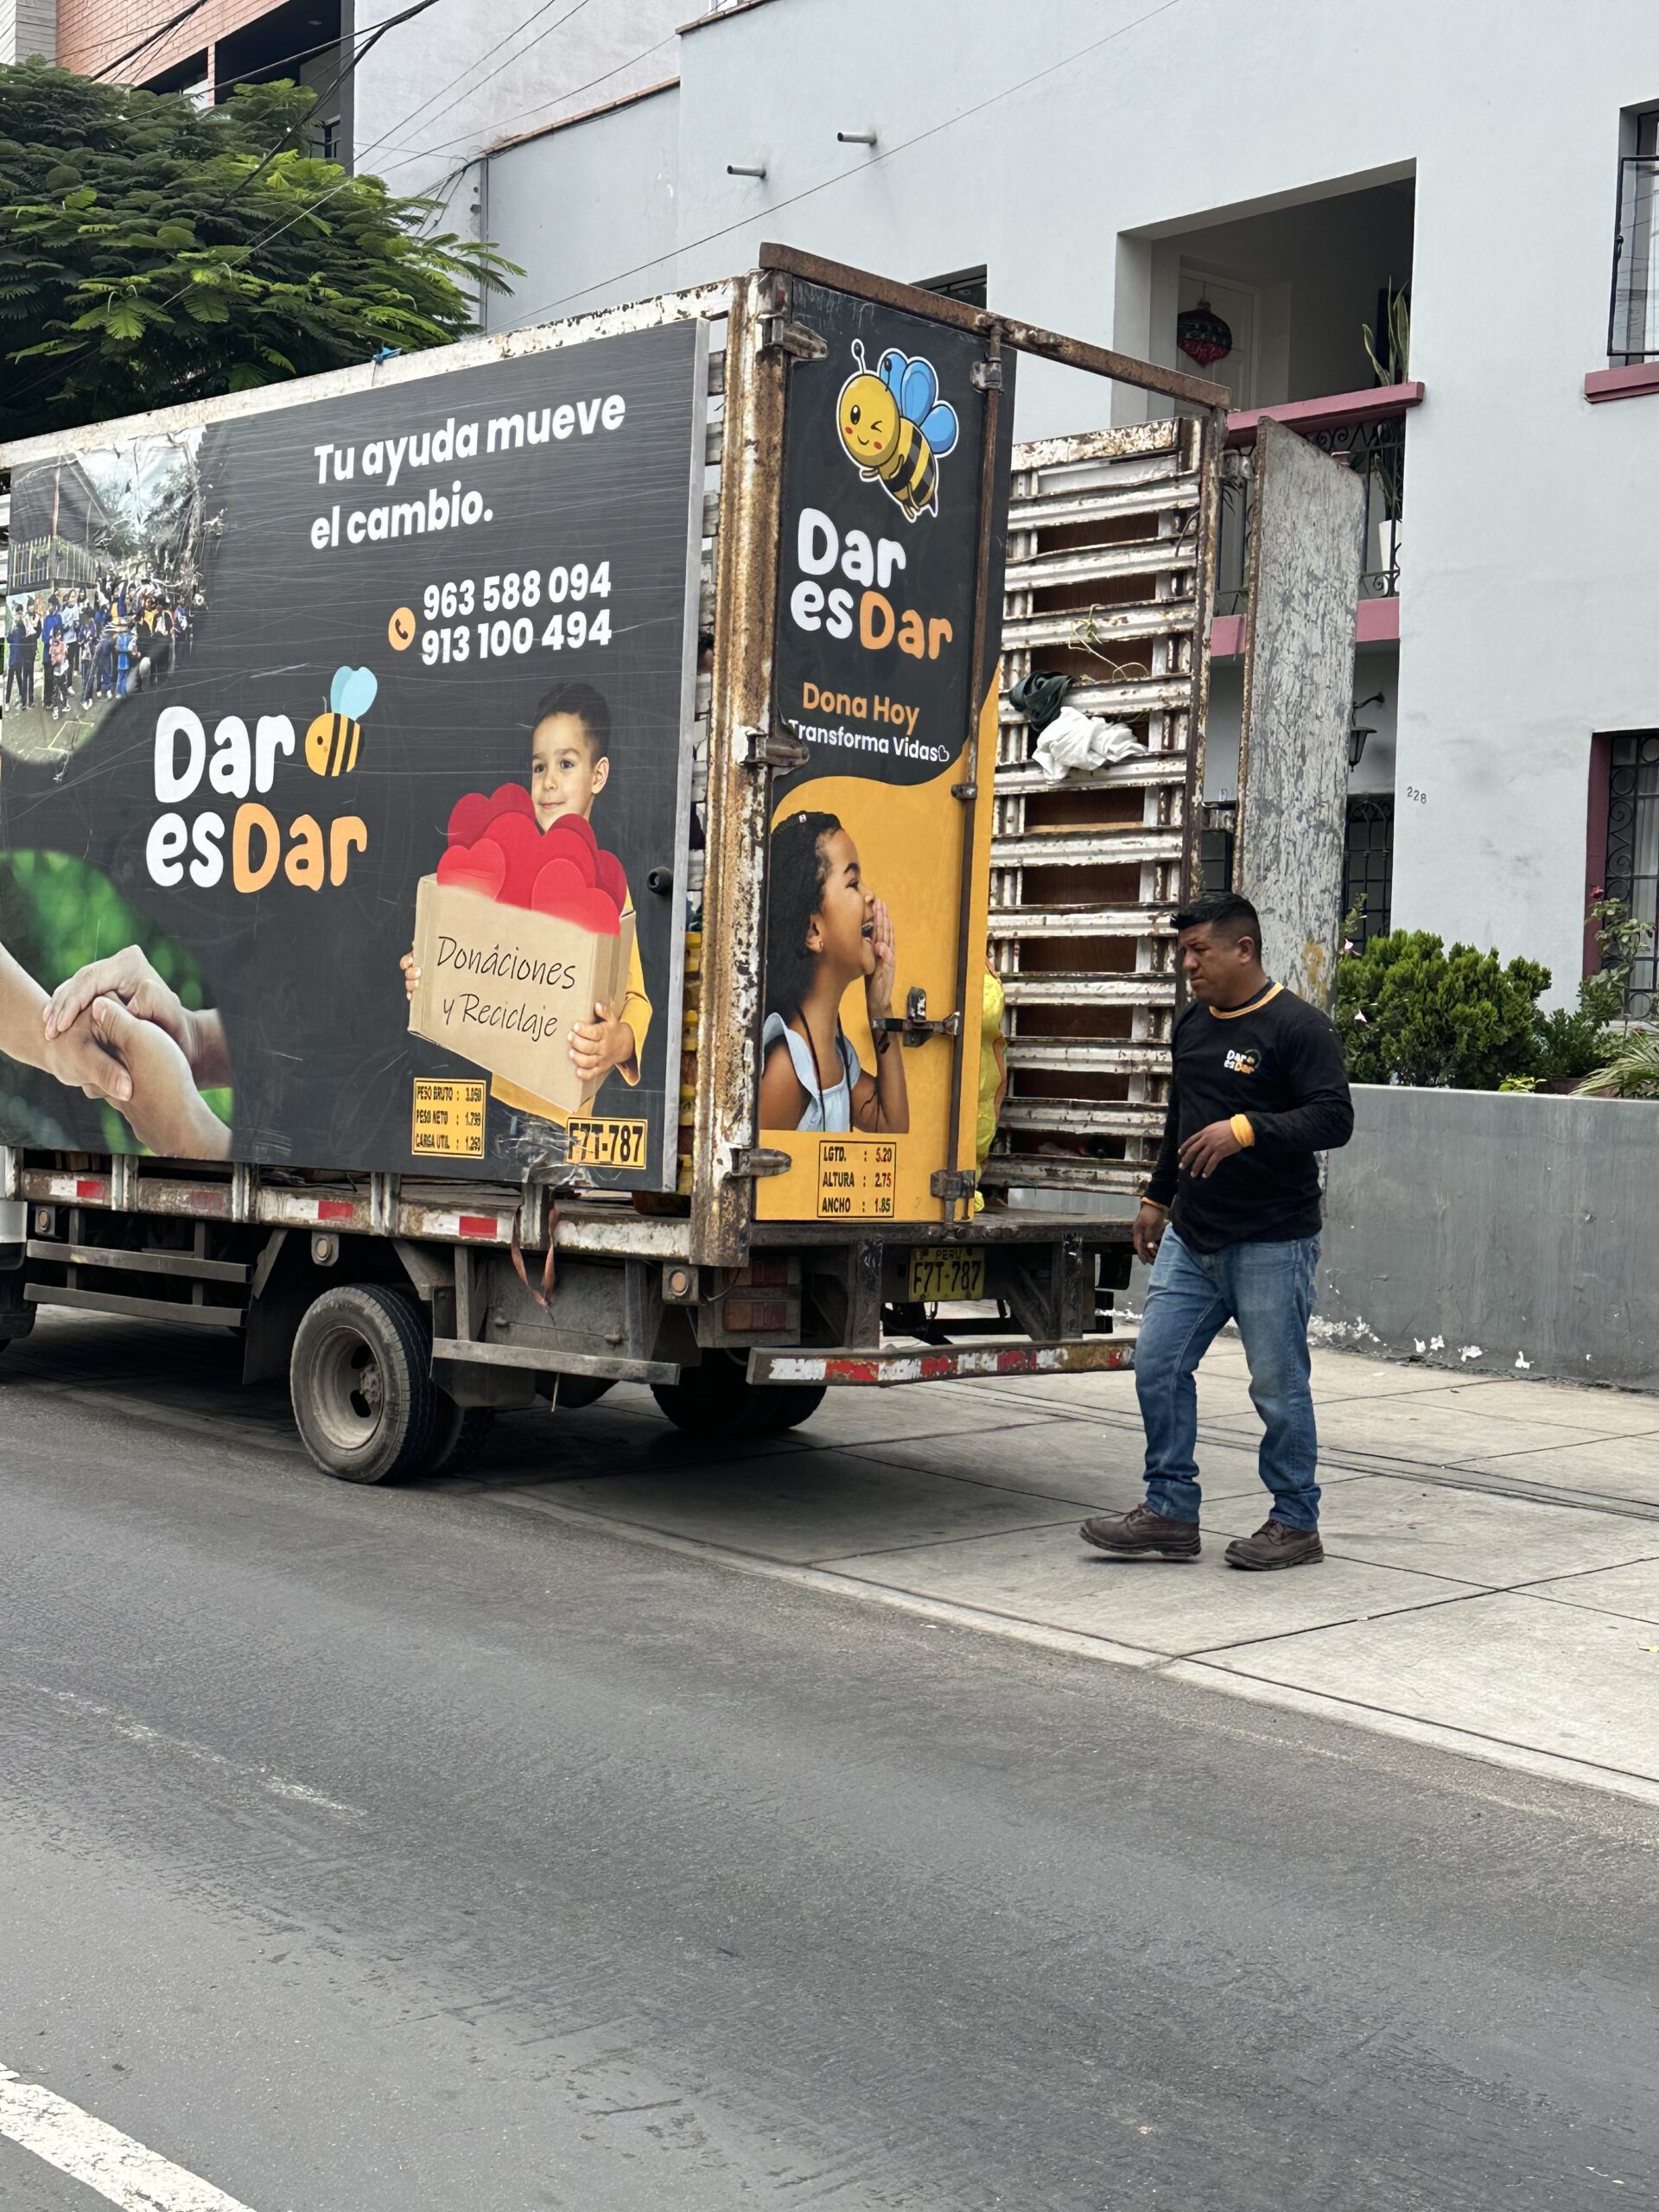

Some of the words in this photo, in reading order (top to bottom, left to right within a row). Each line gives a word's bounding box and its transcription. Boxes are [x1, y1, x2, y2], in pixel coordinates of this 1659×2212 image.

[314, 443, 355, 484] Tu
[361, 418, 479, 486] ayuda
[486, 394, 626, 453] mueve
[310, 505, 341, 550] el
[346, 480, 493, 543] cambio.
[798, 507, 906, 588] Dar
[423, 579, 475, 620] 963
[483, 569, 541, 610] 588
[548, 562, 612, 603] 094
[421, 626, 470, 665] 913
[477, 617, 534, 659] 100
[541, 608, 612, 651] 494
[803, 682, 867, 719] Dona
[873, 695, 920, 735] Hoy
[155, 705, 296, 804] Dar
[788, 719, 889, 753] Transforma
[893, 736, 938, 762] Vidas
[1407, 785, 1427, 804] 228
[443, 998, 455, 1026] y
[460, 994, 558, 1042] Reciclaje
[1226, 1049, 1247, 1063] Dar
[416, 1085, 432, 1100] PESO
[433, 1086, 453, 1101] BRUTO
[416, 1109, 431, 1124] PESO
[433, 1110, 448, 1125] NETO
[416, 1133, 435, 1148] CARGA
[568, 1122, 644, 1162] F7T-787
[823, 1146, 847, 1162] LGTD.
[875, 1147, 893, 1163] 5.20
[822, 1172, 855, 1187] ALTURA
[874, 1172, 892, 1187] 2.75
[822, 1197, 851, 1213] ANCHO
[874, 1197, 891, 1213] 1.85
[935, 1249, 962, 1261] PERU
[913, 1261, 981, 1294] F7T-787
